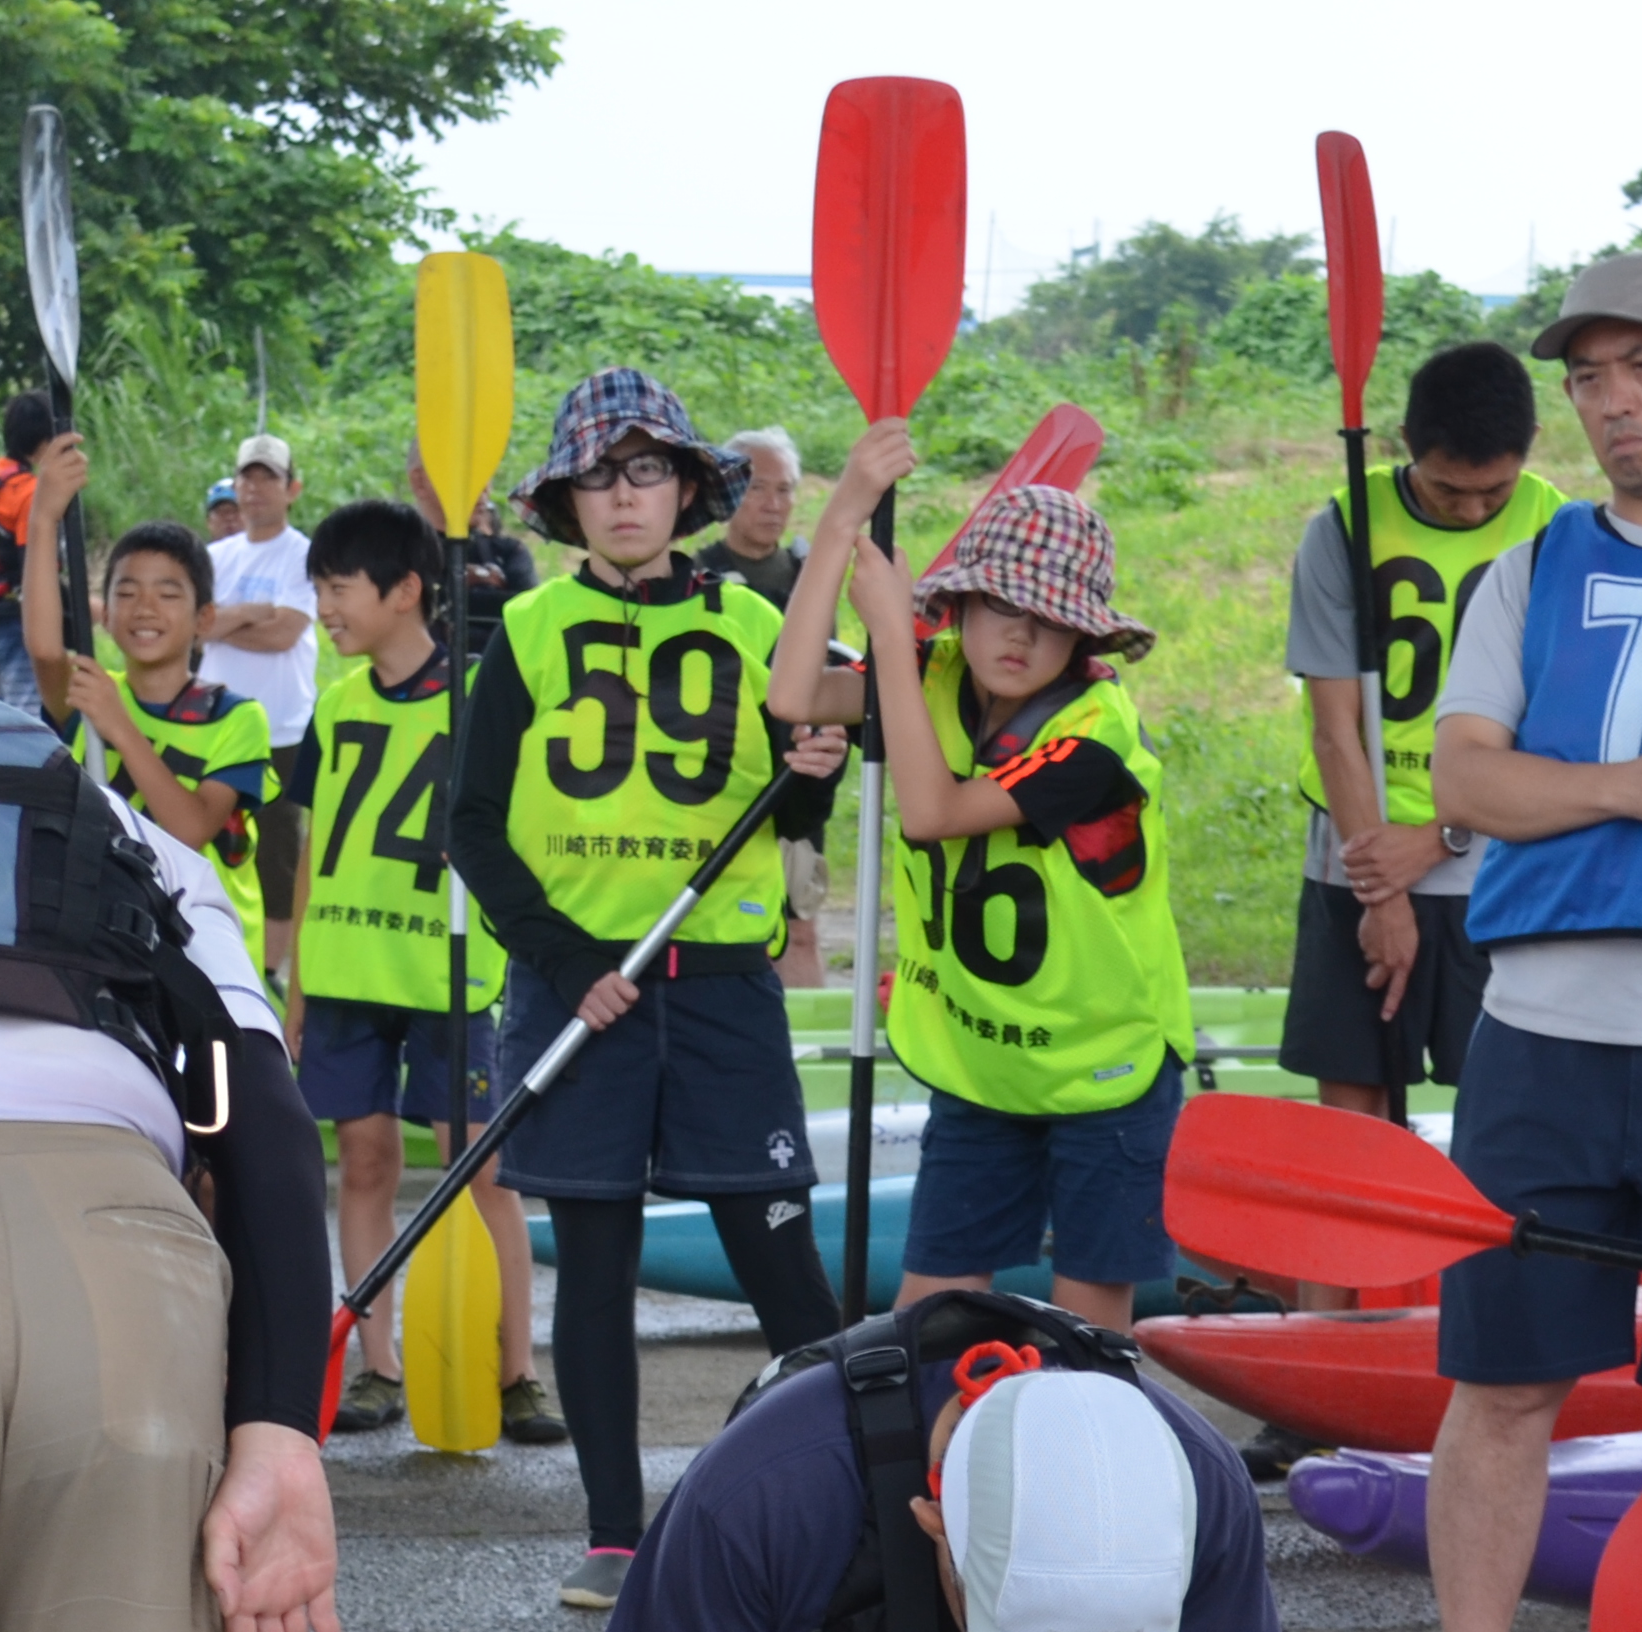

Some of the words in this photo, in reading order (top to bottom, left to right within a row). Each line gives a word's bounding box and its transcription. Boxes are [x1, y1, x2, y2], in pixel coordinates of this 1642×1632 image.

[546, 619, 743, 806] 59
[1371, 555, 1495, 722] 6
[318, 720, 449, 894] 74
